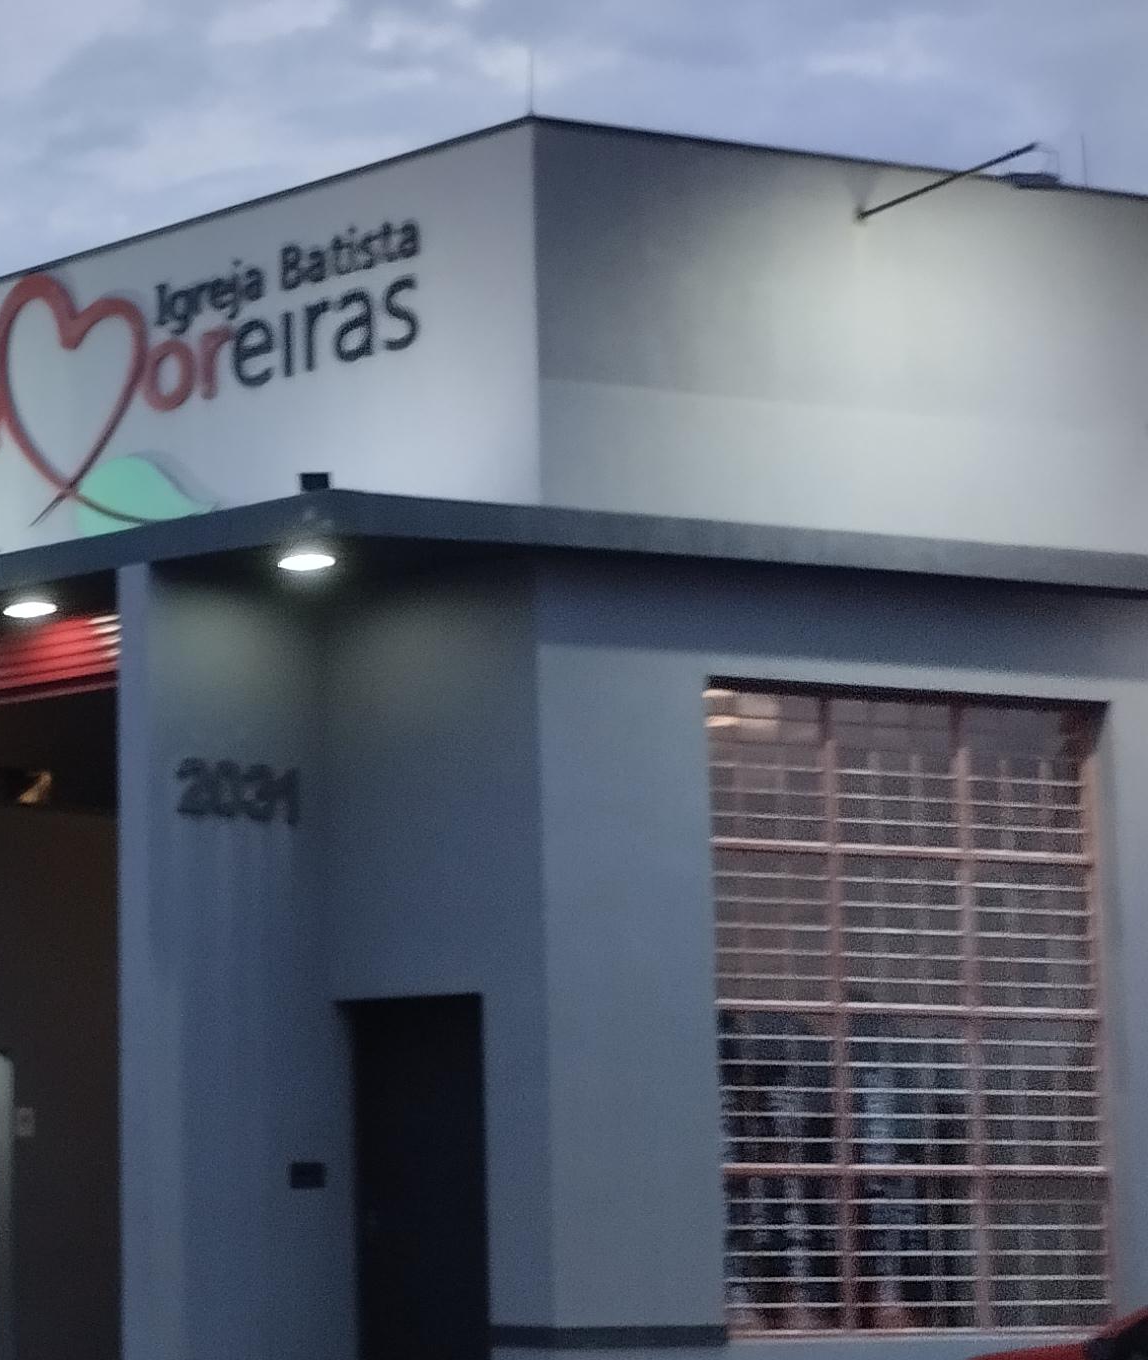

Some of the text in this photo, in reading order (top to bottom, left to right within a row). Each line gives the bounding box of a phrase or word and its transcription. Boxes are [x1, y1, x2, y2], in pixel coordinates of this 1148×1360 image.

[153, 218, 420, 334] Igreja Batista
[175, 756, 301, 827] 2031
